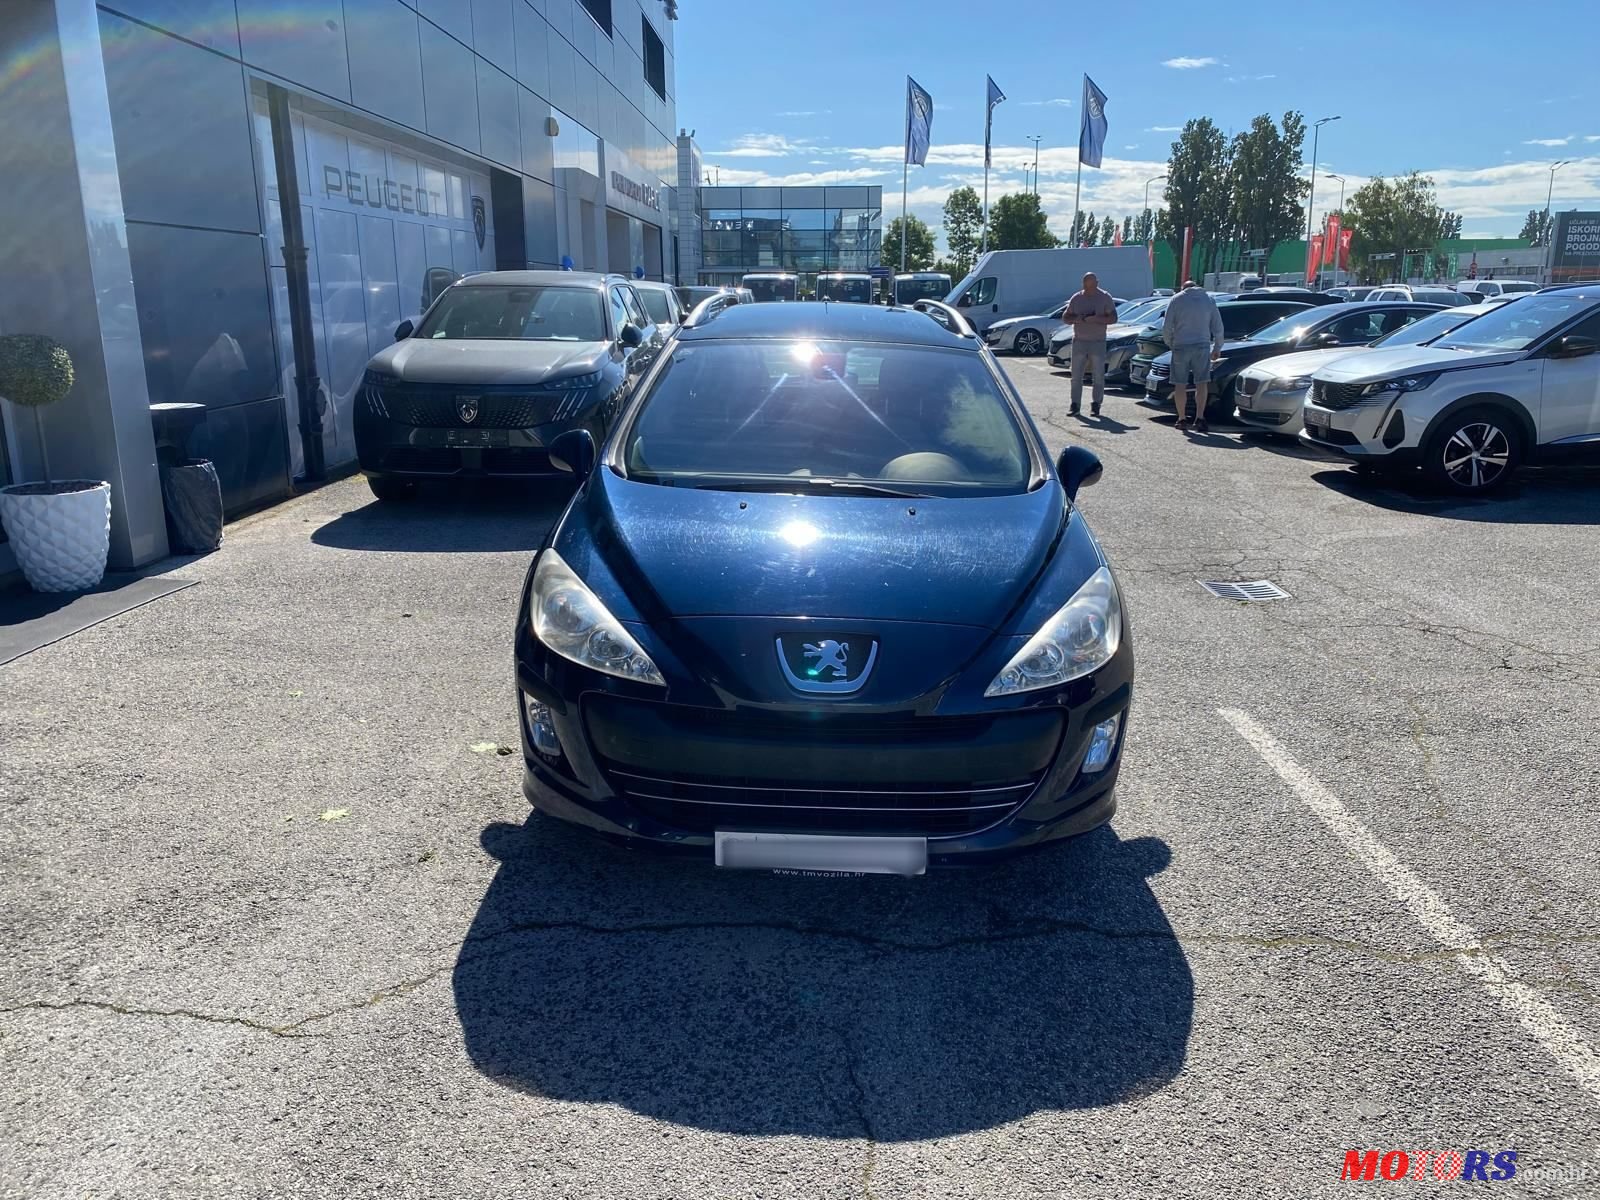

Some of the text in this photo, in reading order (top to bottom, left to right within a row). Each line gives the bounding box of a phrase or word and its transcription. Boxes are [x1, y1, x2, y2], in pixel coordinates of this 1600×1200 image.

[323, 165, 441, 219] PEUGEOT
[1568, 225, 1600, 233] ISKORI
[1566, 234, 1600, 242] BROJN
[772, 868, 865, 878] www.tmvozila.hr
